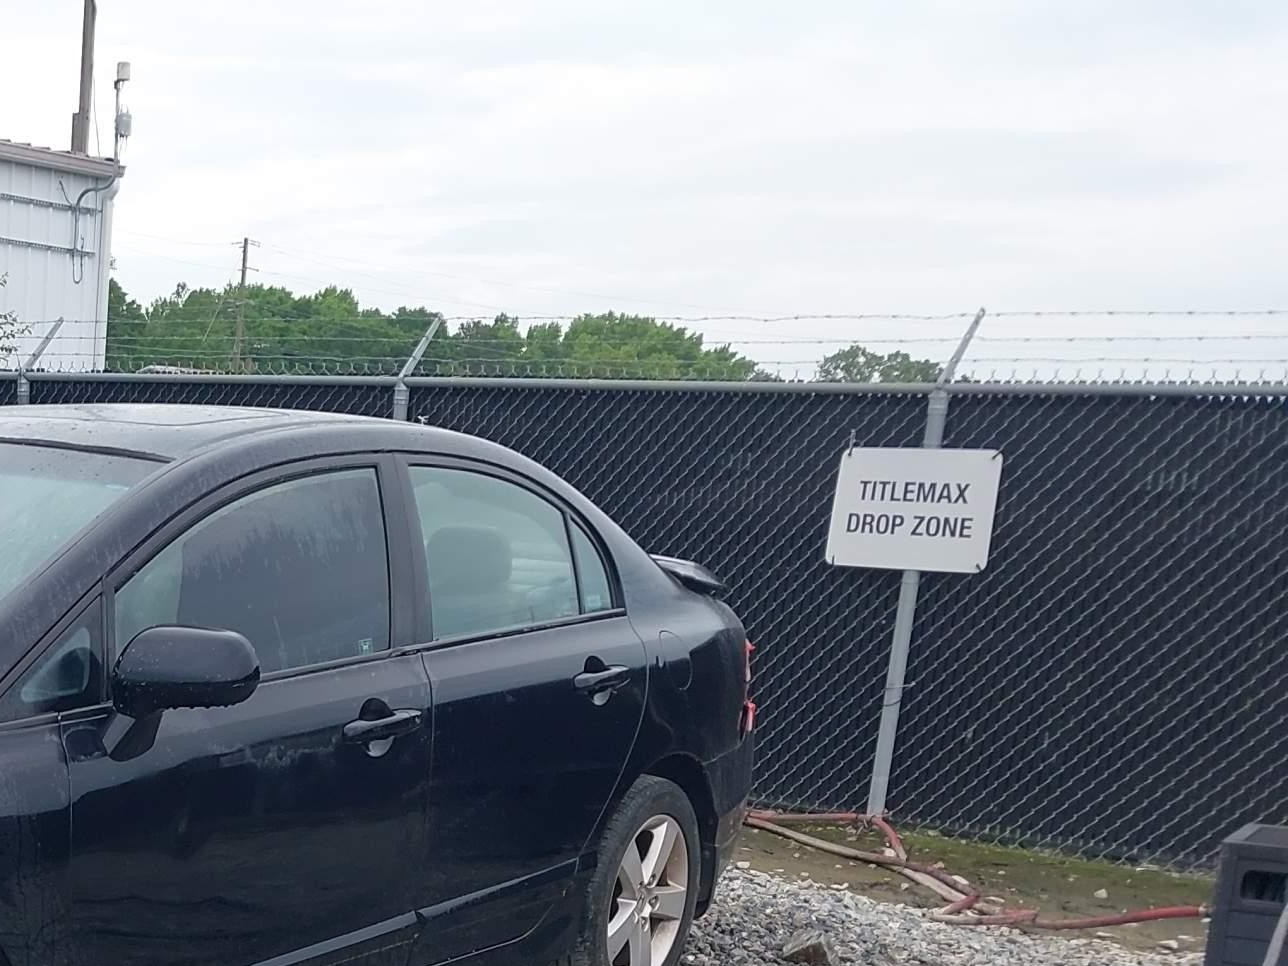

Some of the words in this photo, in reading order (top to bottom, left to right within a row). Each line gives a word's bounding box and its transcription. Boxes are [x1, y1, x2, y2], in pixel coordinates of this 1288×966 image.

[859, 480, 971, 504] TITLEMAX
[845, 512, 905, 535] DROP
[910, 515, 974, 539] ZONE
